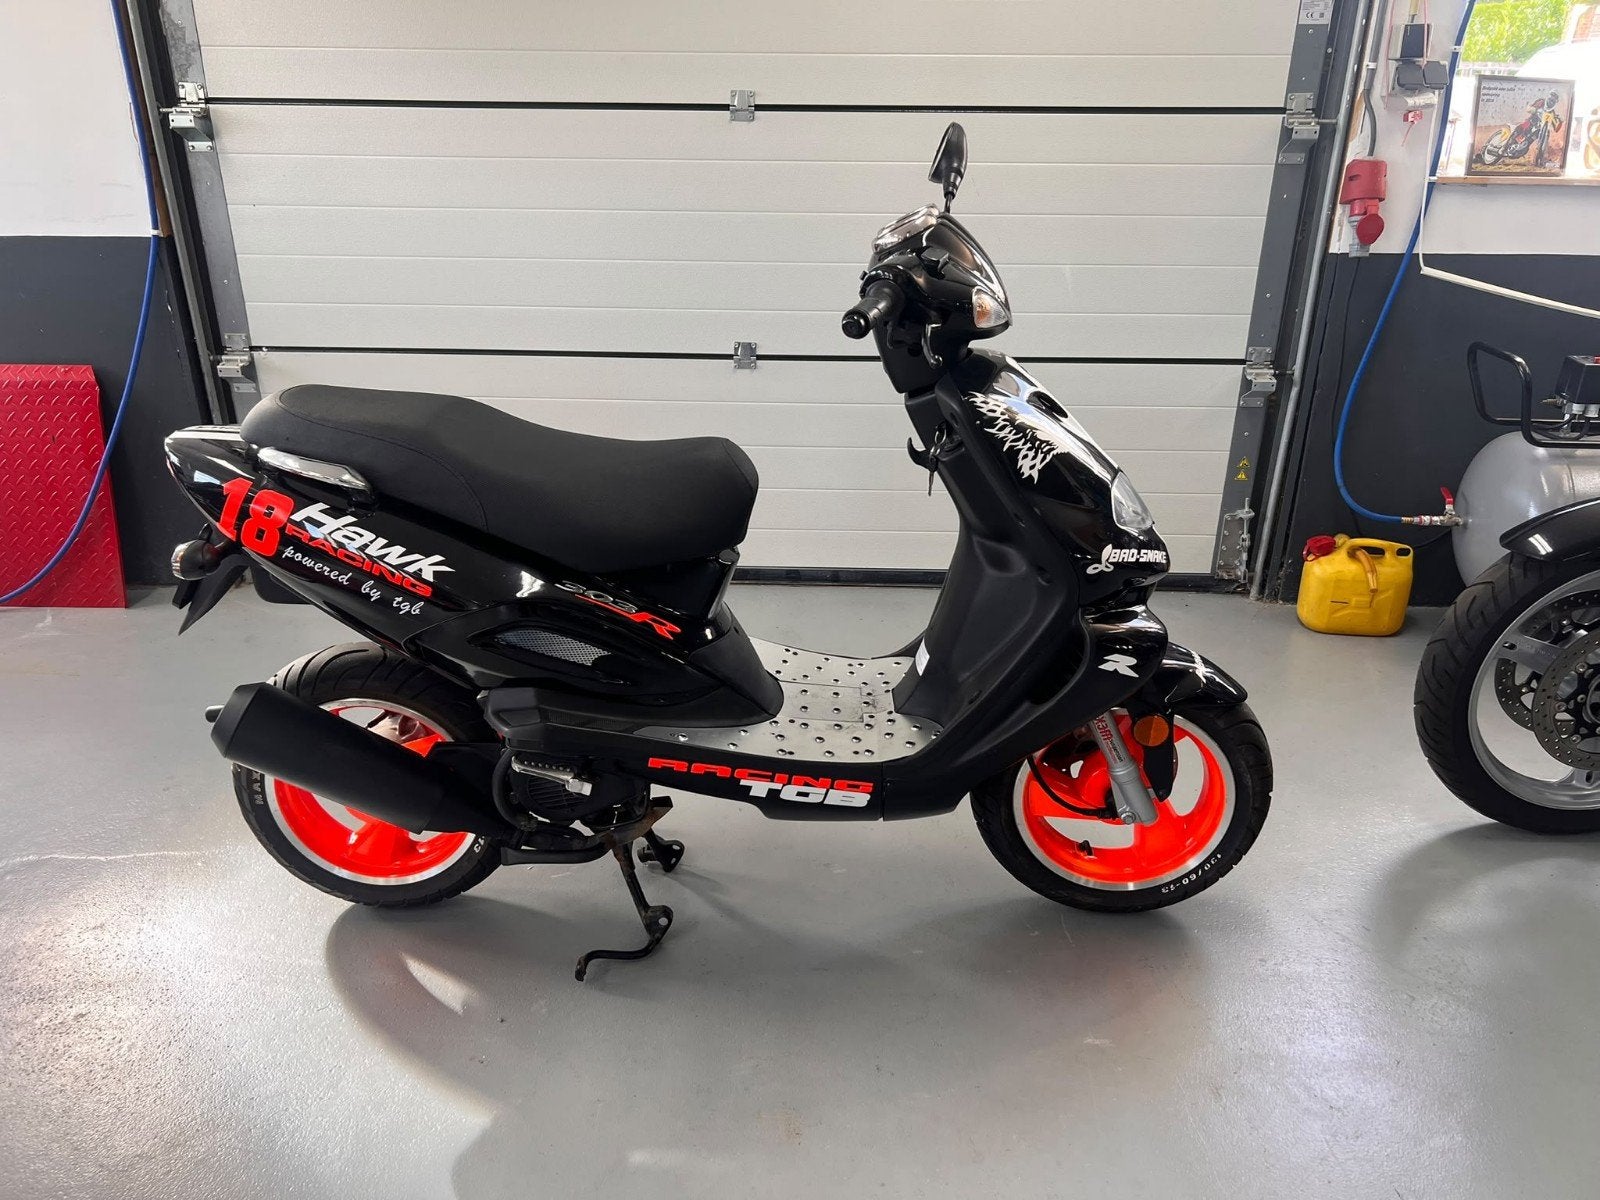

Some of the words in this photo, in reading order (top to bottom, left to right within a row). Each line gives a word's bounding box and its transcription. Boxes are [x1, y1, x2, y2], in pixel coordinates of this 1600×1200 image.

[217, 477, 295, 557] 18
[285, 523, 433, 597] RACING
[290, 502, 456, 583] Hawk
[1110, 548, 1167, 564] BAD-SNAKE
[281, 544, 350, 586] powered
[360, 580, 382, 602] by
[392, 594, 423, 616] tgb
[1097, 653, 1140, 679] R
[251, 771, 264, 805] MAX
[647, 757, 875, 793] RACING
[738, 778, 872, 808] TGB
